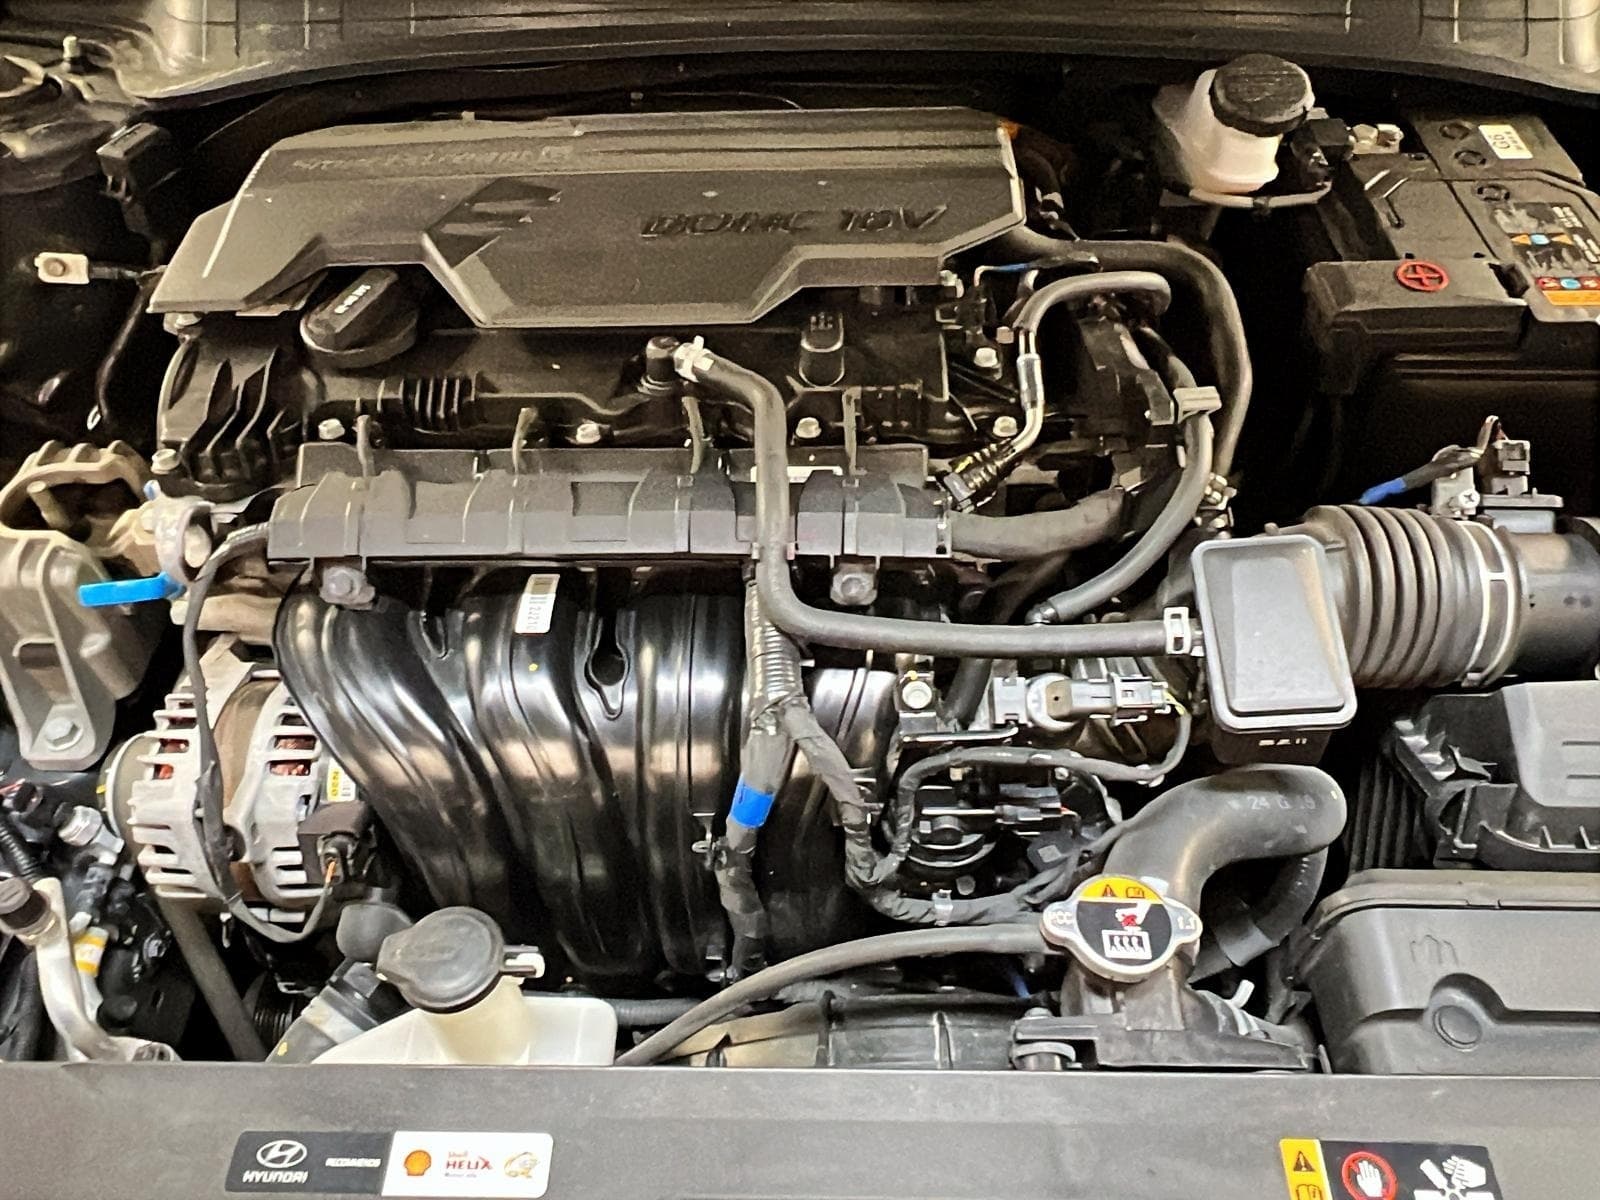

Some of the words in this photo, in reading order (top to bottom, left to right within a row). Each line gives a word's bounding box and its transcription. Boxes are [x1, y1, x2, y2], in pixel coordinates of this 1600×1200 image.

[639, 211, 820, 237] DOHC
[838, 203, 948, 233] 16V
[445, 1156, 494, 1170] HELIX
[242, 1169, 309, 1184] HYUNDAI
